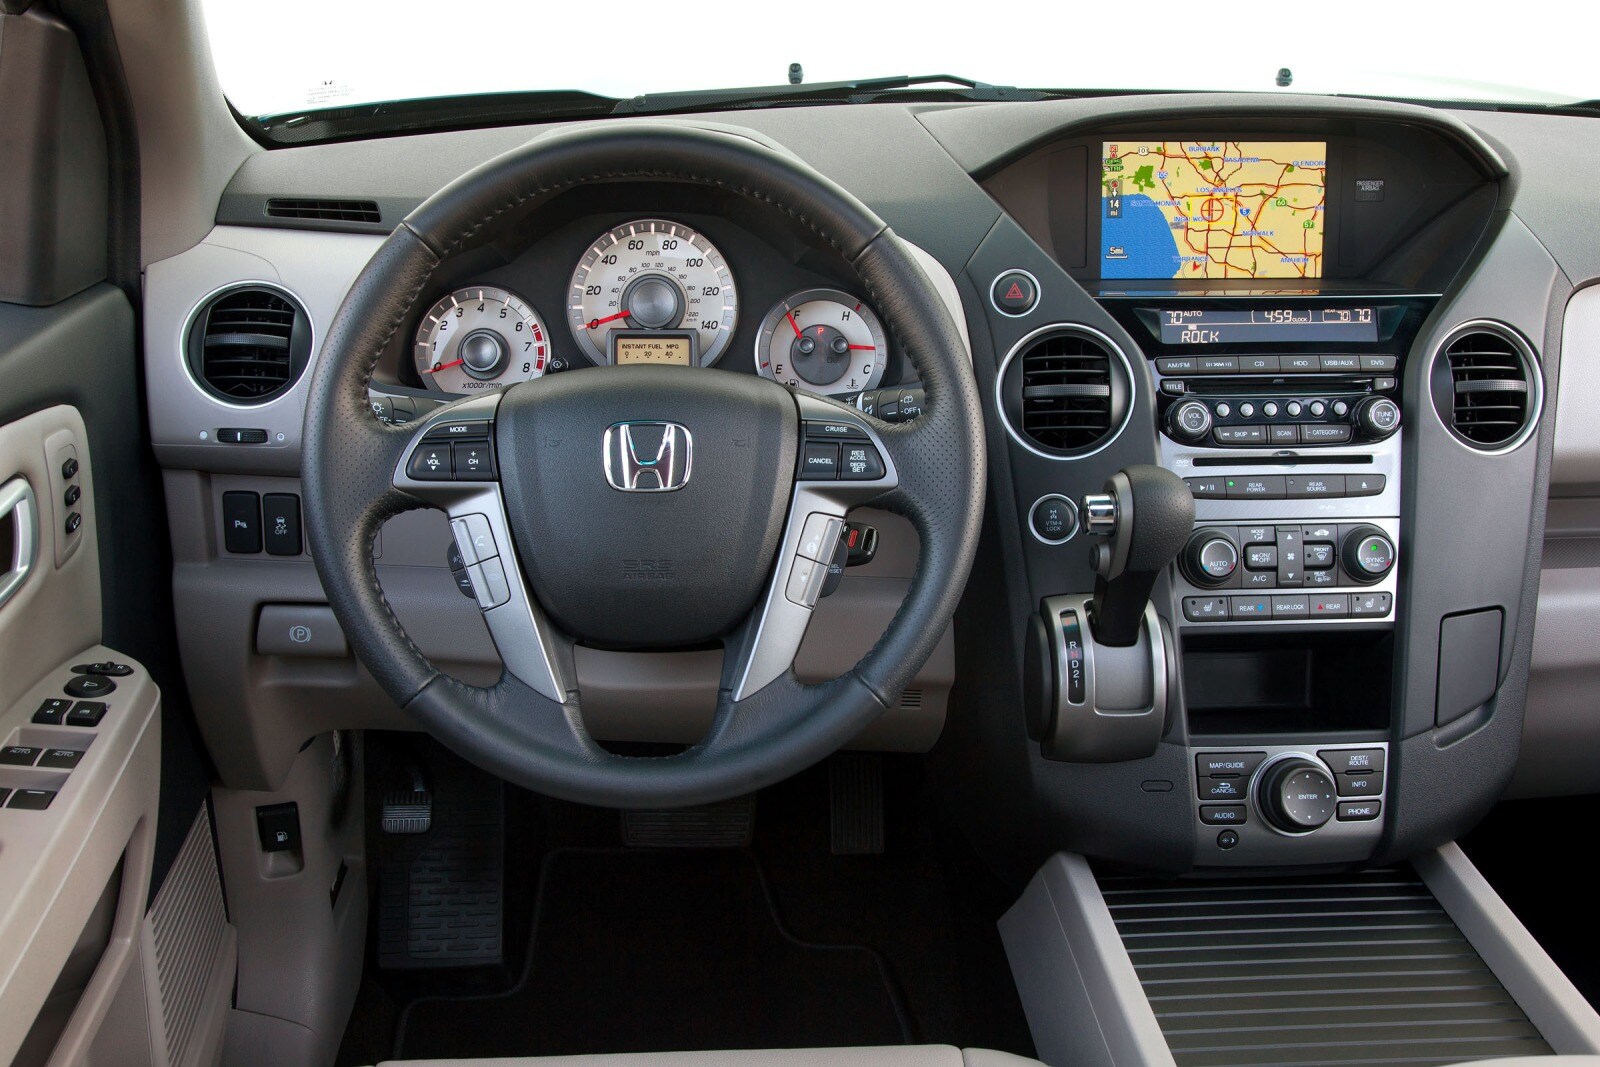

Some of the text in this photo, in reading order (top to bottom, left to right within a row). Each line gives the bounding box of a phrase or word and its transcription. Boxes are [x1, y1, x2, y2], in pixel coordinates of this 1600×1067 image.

[1110, 200, 1119, 208] 14
[628, 240, 644, 250] 60
[662, 240, 677, 250] 80
[602, 255, 617, 265] 40
[686, 258, 703, 267] 100
[586, 286, 601, 295] 20
[702, 287, 719, 296] 120
[478, 303, 484, 312] 4
[456, 308, 463, 318] 3
[500, 308, 507, 318] 5
[794, 311, 800, 320] F
[842, 311, 850, 320] H
[1166, 311, 1183, 324] 70
[1265, 310, 1292, 322] 4:59
[1338, 311, 1348, 321] 70
[1355, 309, 1371, 322] 70
[440, 320, 448, 330] 2
[516, 322, 522, 331] 6
[591, 319, 598, 329] 0
[701, 321, 718, 329] 140
[1182, 330, 1219, 343] ROCK
[433, 342, 436, 351] 1
[524, 342, 532, 351] 7
[434, 362, 442, 372] 0
[523, 363, 530, 372] 8
[776, 365, 782, 374] E
[863, 365, 870, 374] C
